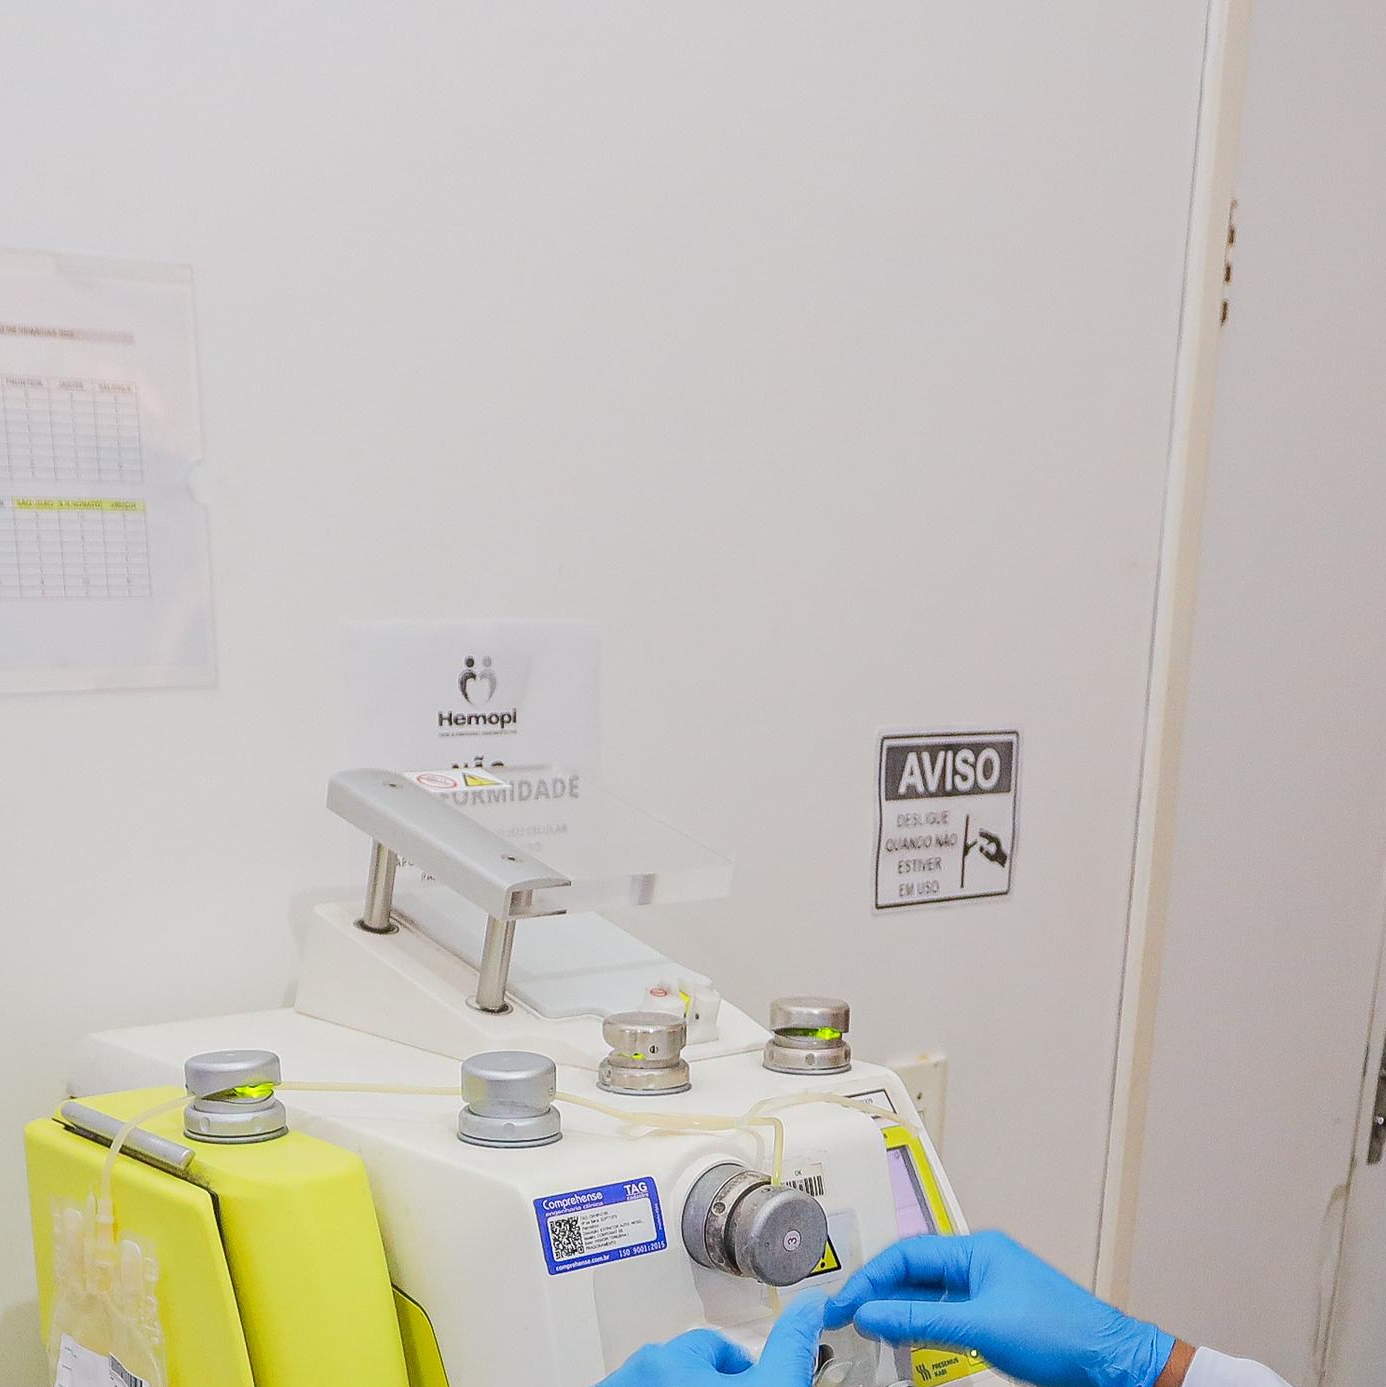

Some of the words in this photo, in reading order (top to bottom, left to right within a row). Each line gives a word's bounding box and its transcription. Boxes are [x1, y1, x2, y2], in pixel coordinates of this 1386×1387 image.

[436, 707, 518, 729] Hemopi
[897, 747, 1002, 796] AVISO
[896, 809, 950, 828] DESLIGUE
[885, 837, 933, 852] QUANDO
[897, 856, 943, 875] ESTIVER
[898, 883, 916, 897] EM
[918, 880, 941, 896] USO
[623, 1181, 648, 1196] TAG
[542, 1191, 604, 1211] Comprehense
[618, 1248, 631, 1259] ISO
[555, 1254, 610, 1273] comprehense.com.br
[931, 1356, 960, 1371] FRESENIUS
[934, 1369, 948, 1378] KABI
